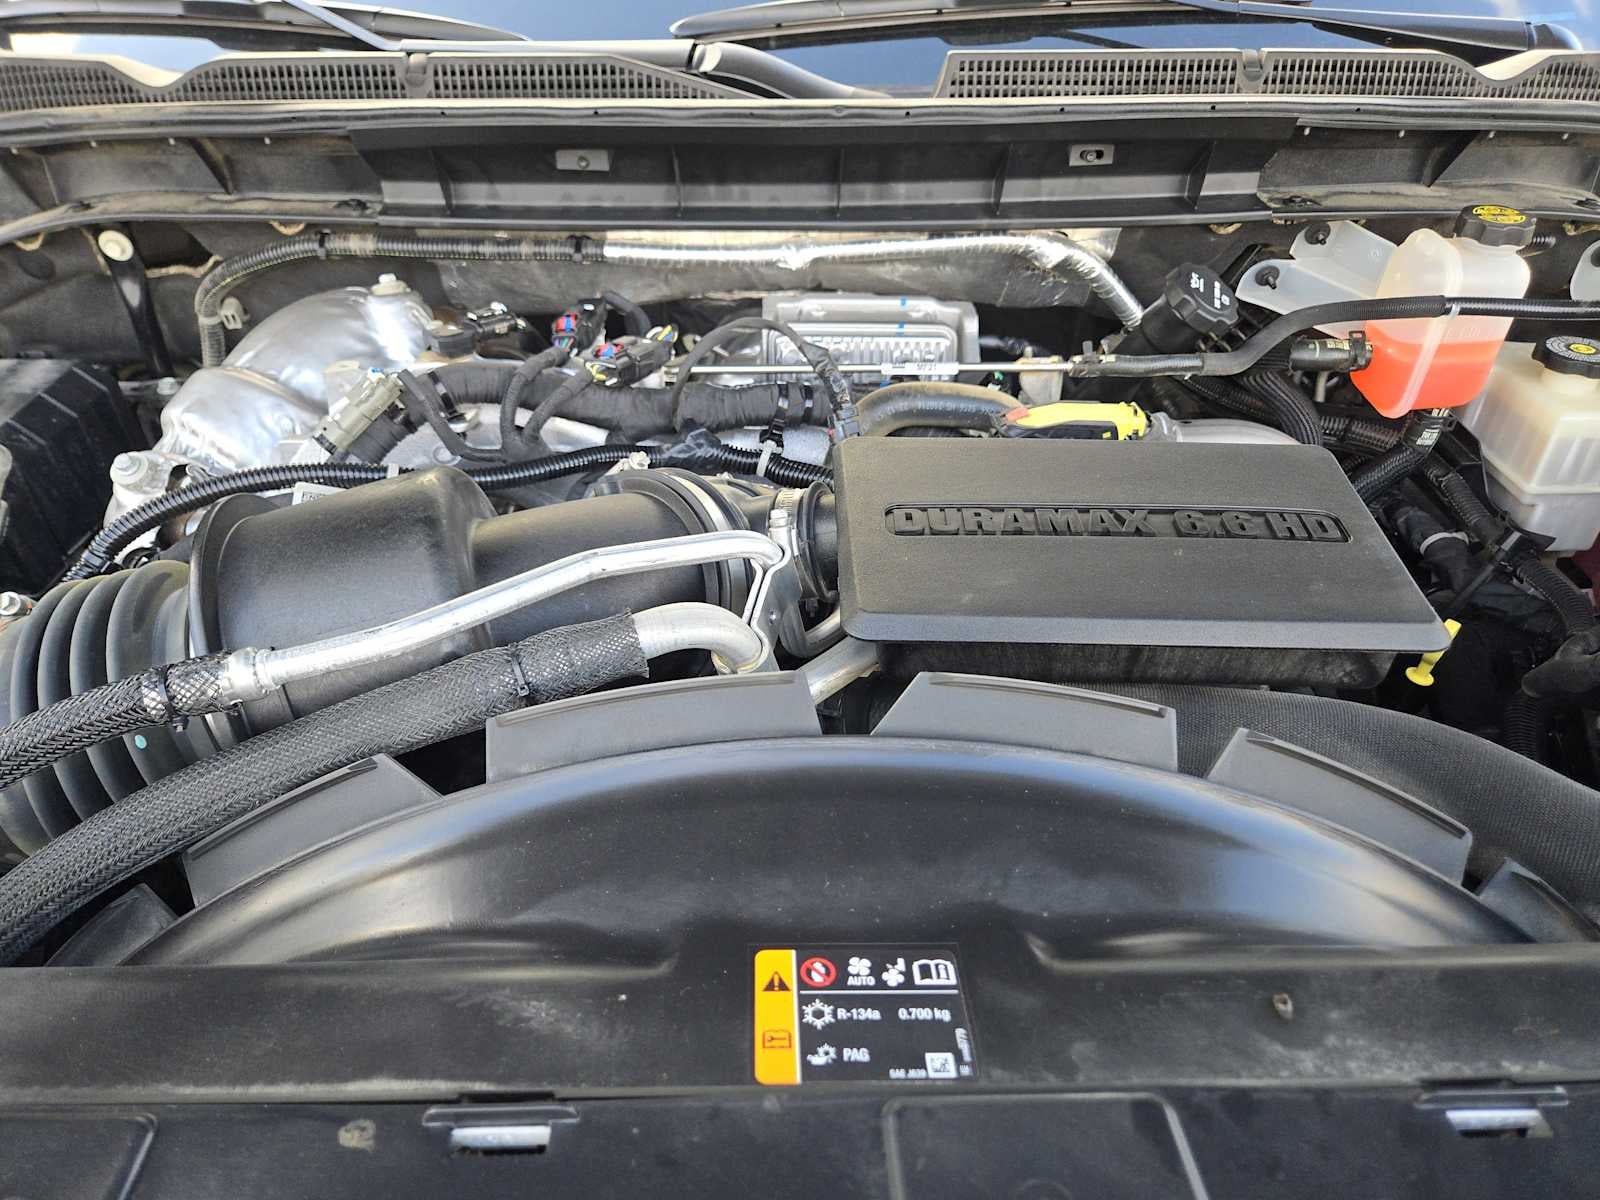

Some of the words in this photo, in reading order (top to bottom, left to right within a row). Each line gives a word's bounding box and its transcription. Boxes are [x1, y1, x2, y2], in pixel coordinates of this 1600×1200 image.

[892, 506, 1155, 537] DURAMAX
[1173, 508, 1259, 540] 6.6
[1265, 511, 1346, 543] HD
[847, 975, 876, 986] AUTO
[837, 1007, 882, 1021] R-134a
[898, 1007, 933, 1020] 0.700
[934, 1007, 952, 1023] kg
[843, 1047, 870, 1063] PAG
